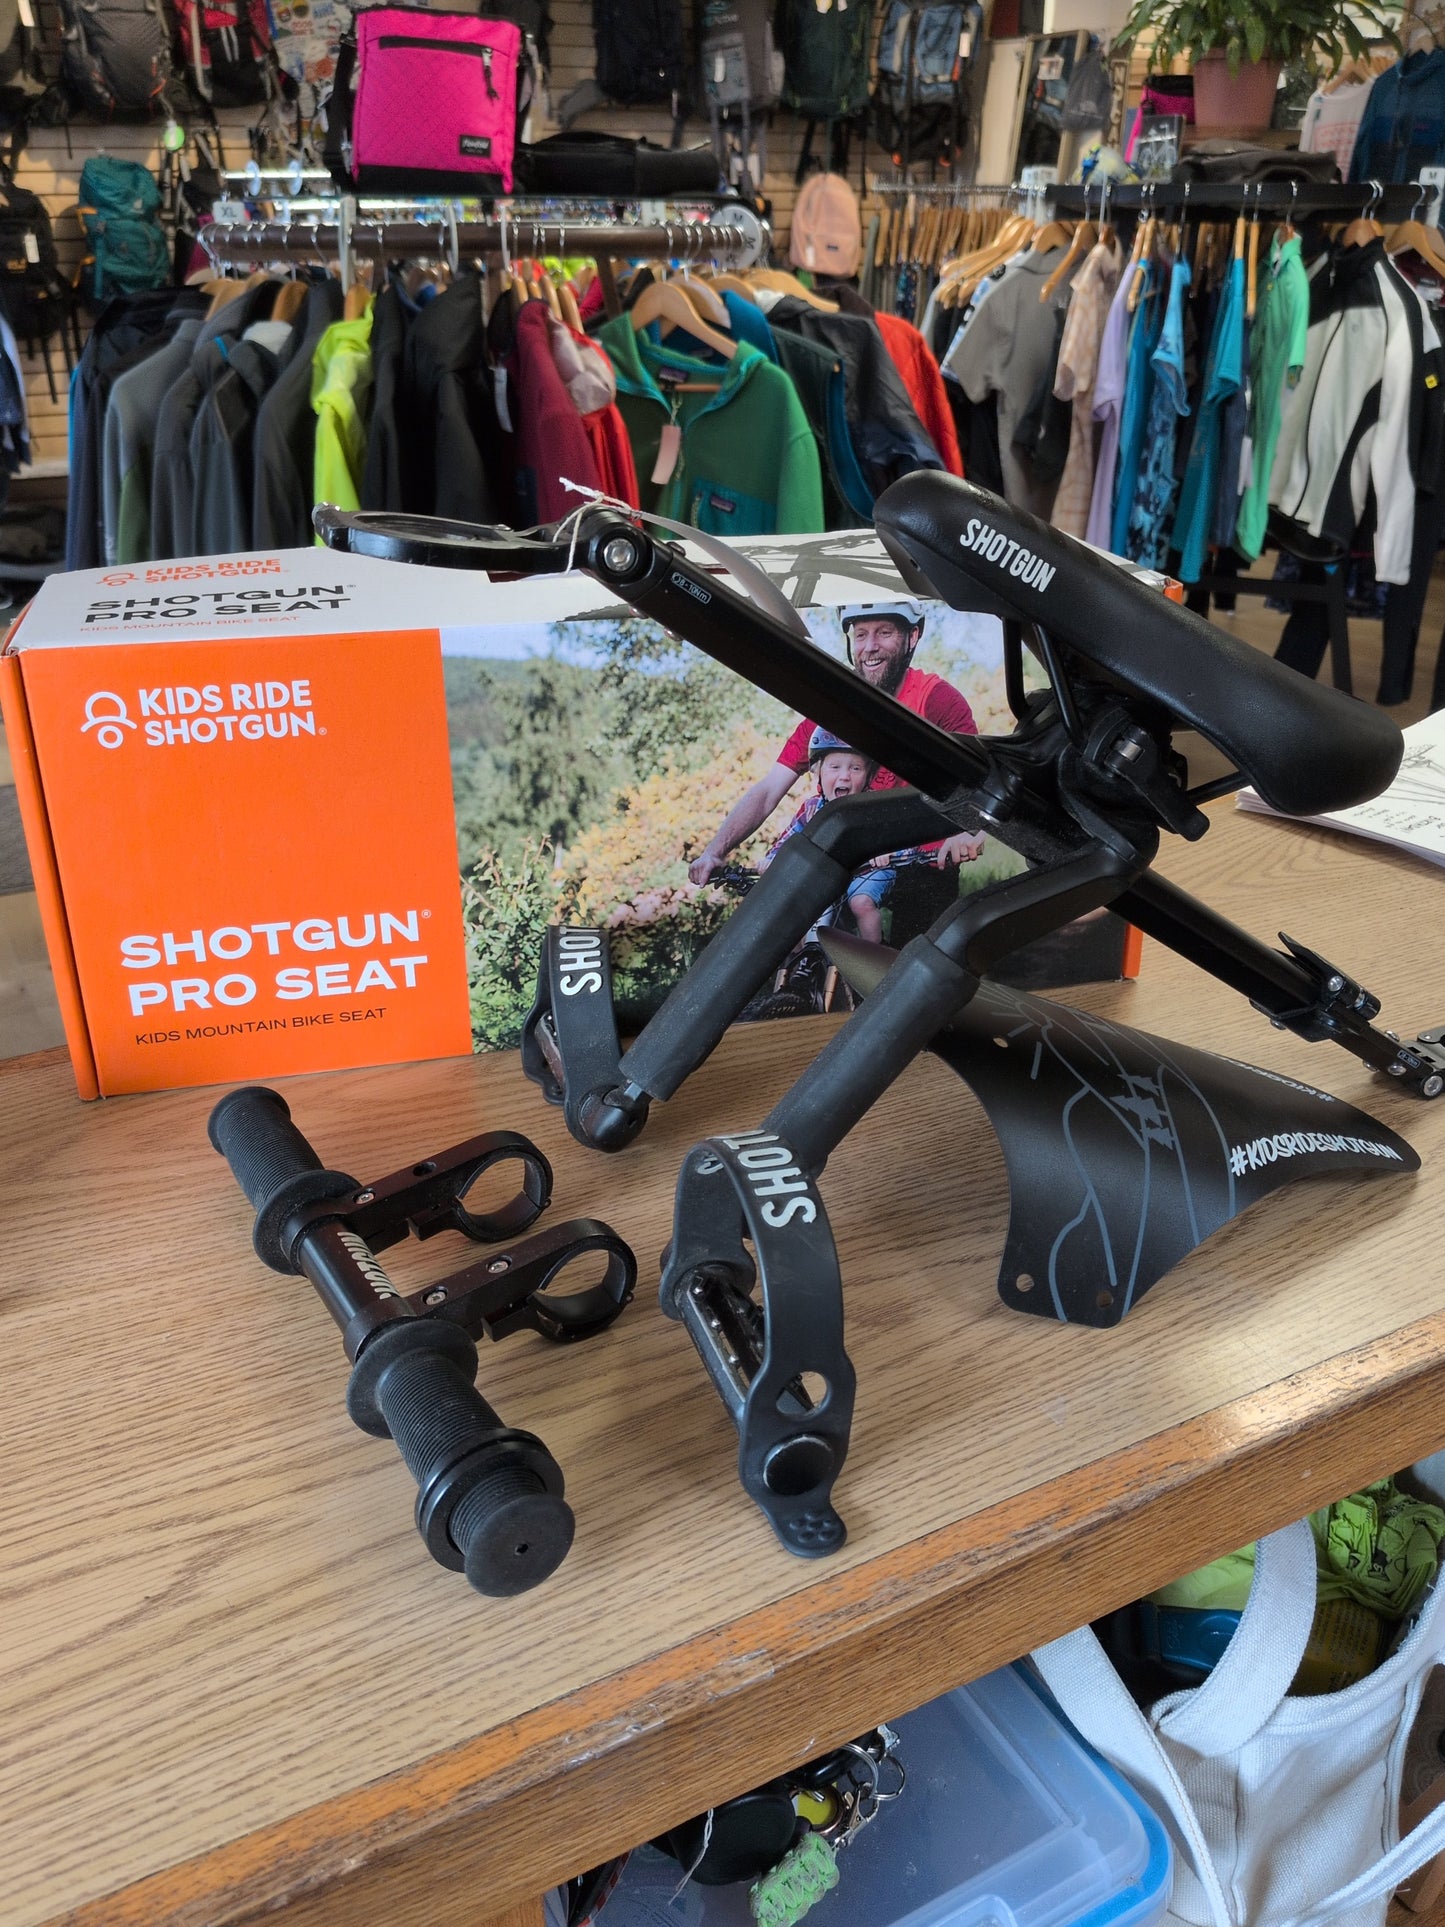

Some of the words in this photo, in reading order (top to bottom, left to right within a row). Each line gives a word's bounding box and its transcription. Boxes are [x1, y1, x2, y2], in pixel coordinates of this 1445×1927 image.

[221, 206, 237, 218] XL
[146, 564, 210, 577] KIDS
[218, 558, 280, 571] RIDE
[959, 518, 1056, 593] SHOTGUN
[144, 567, 281, 584] SHOTGUN
[85, 608, 197, 623] PRO
[214, 598, 351, 616] SEAT
[124, 620, 212, 631] MOUNTAIN
[216, 617, 254, 626] BIKE
[258, 615, 300, 624] SEAT
[138, 683, 224, 717] KIDS
[230, 679, 313, 711] RIDE
[128, 973, 257, 1017] PRO
[275, 955, 428, 1001] SEAT
[136, 1030, 181, 1046] KIDS
[185, 1017, 288, 1040] MOUNTAIN
[292, 1012, 334, 1028] BIKE
[339, 1007, 388, 1022] SEAT
[1230, 1132, 1404, 1177] #KIDSRIDESHOTGUN
[706, 1129, 817, 1228] SHOT
